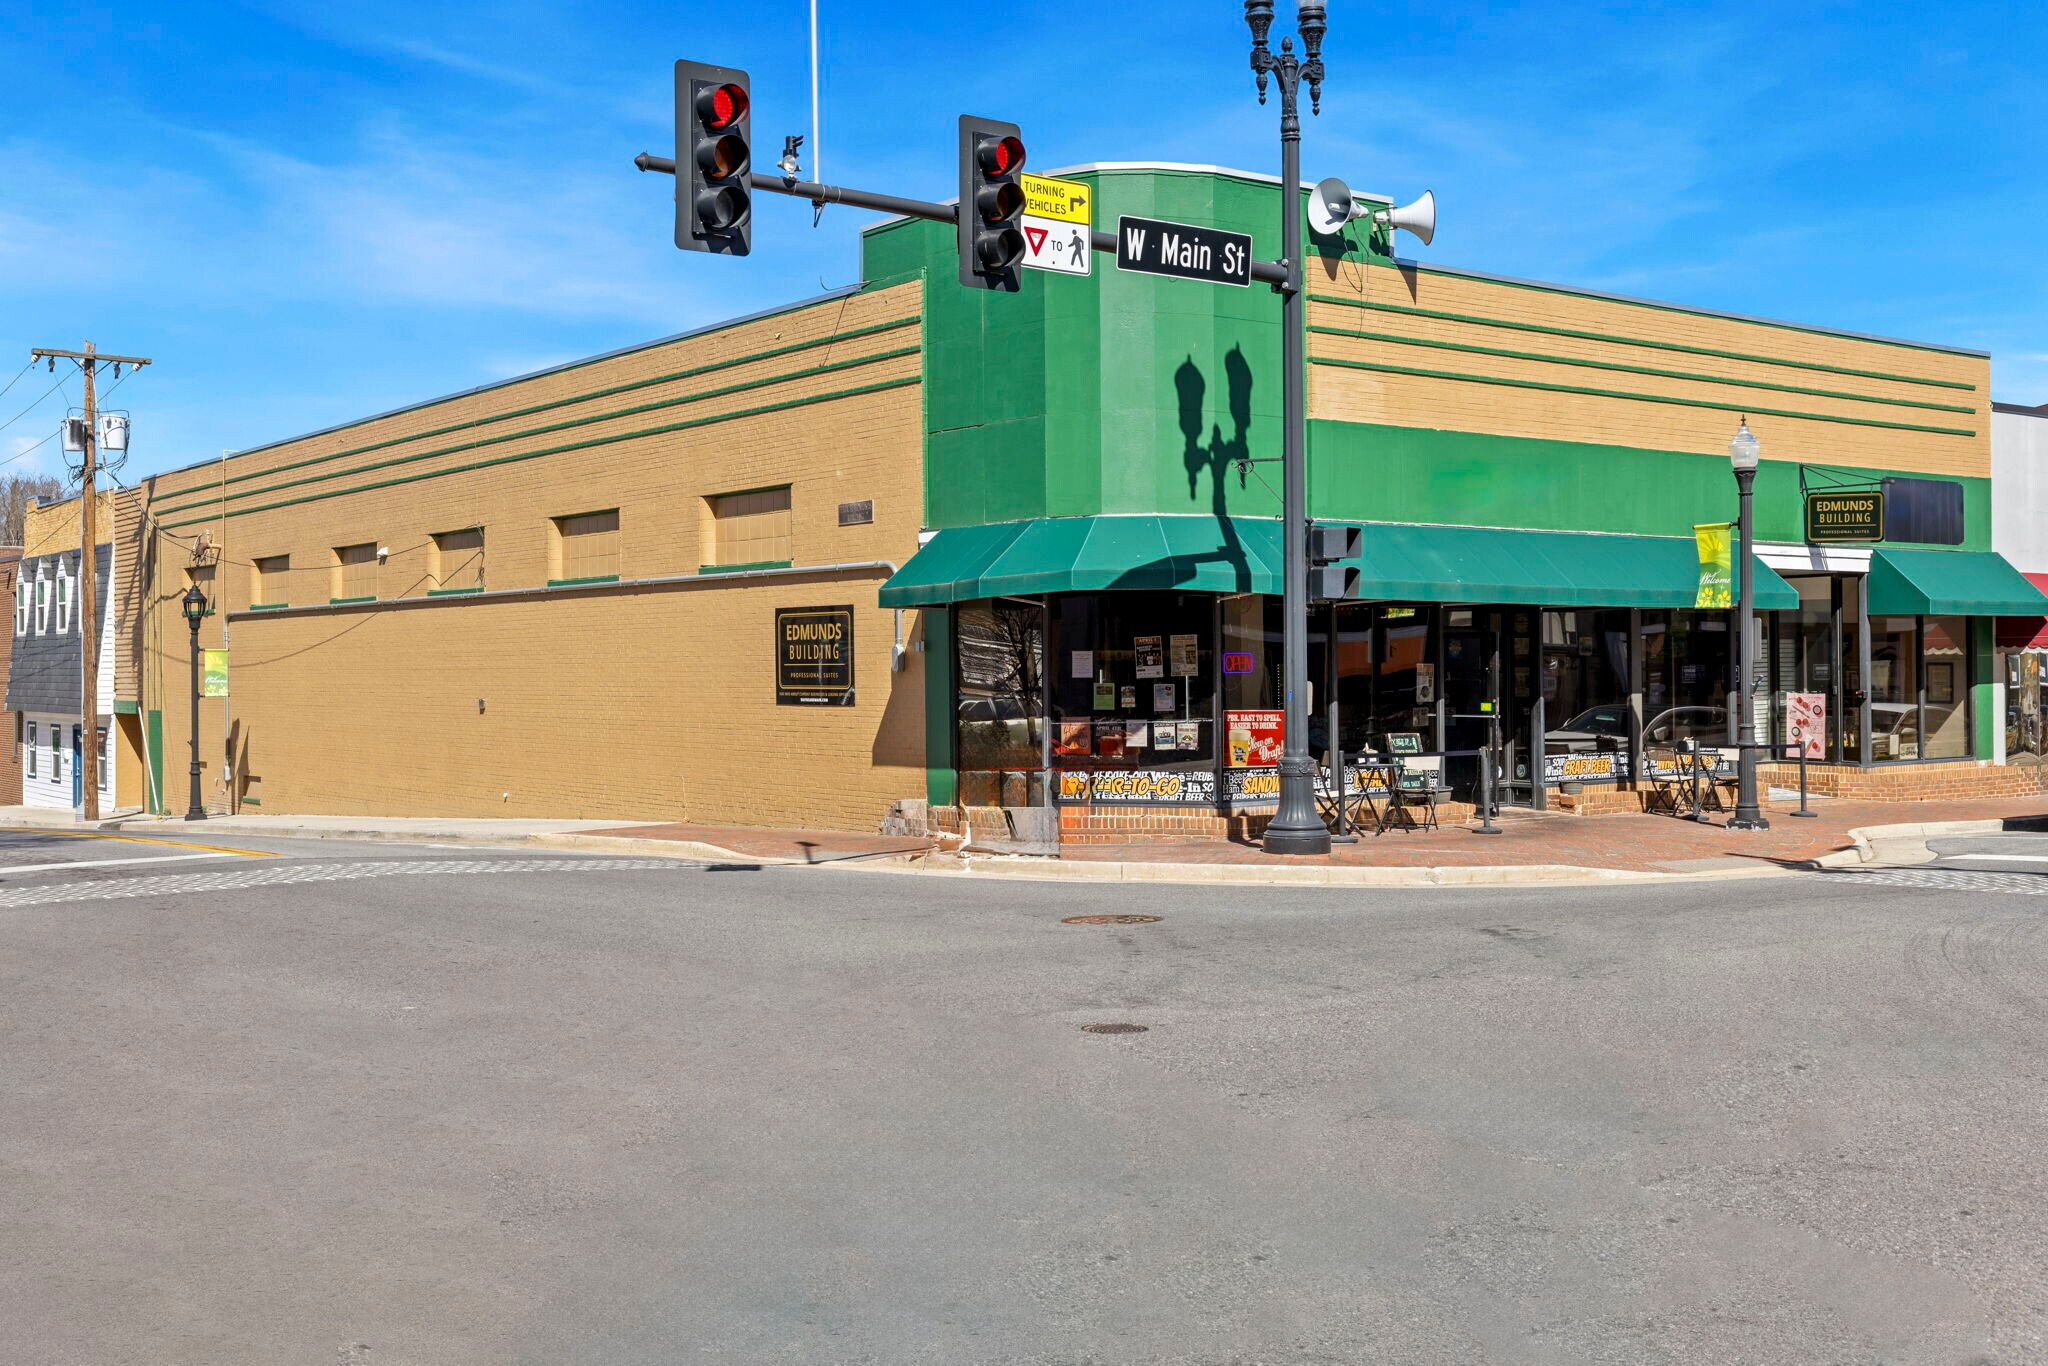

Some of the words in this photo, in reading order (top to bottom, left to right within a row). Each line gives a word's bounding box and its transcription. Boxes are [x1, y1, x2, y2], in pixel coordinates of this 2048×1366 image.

[1024, 181, 1065, 198] TURNING
[1024, 197, 1067, 215] VEHICLES
[1051, 240, 1063, 252] TO
[1126, 227, 1146, 261] W
[1161, 232, 1211, 271] Main
[1222, 243, 1245, 276] St
[1816, 500, 1874, 512] EDMUNDS
[1819, 512, 1871, 523] BUILDING
[1700, 569, 1731, 585] Welcome
[786, 623, 842, 641] EDMUNDS
[789, 643, 840, 660] BUILDING
[1226, 655, 1252, 671] OPEN
[1230, 722, 1252, 730] EASIER
[1252, 722, 1259, 730] TO
[1240, 714, 1256, 722] EASY
[1256, 714, 1263, 722] TO
[1248, 736, 1263, 752] Now
[1264, 737, 1274, 746] on
[1259, 740, 1285, 761] Draft!
[1564, 760, 1589, 776] CRAFT
[1590, 758, 1610, 775] BEER
[1185, 792, 1204, 801] BEER
